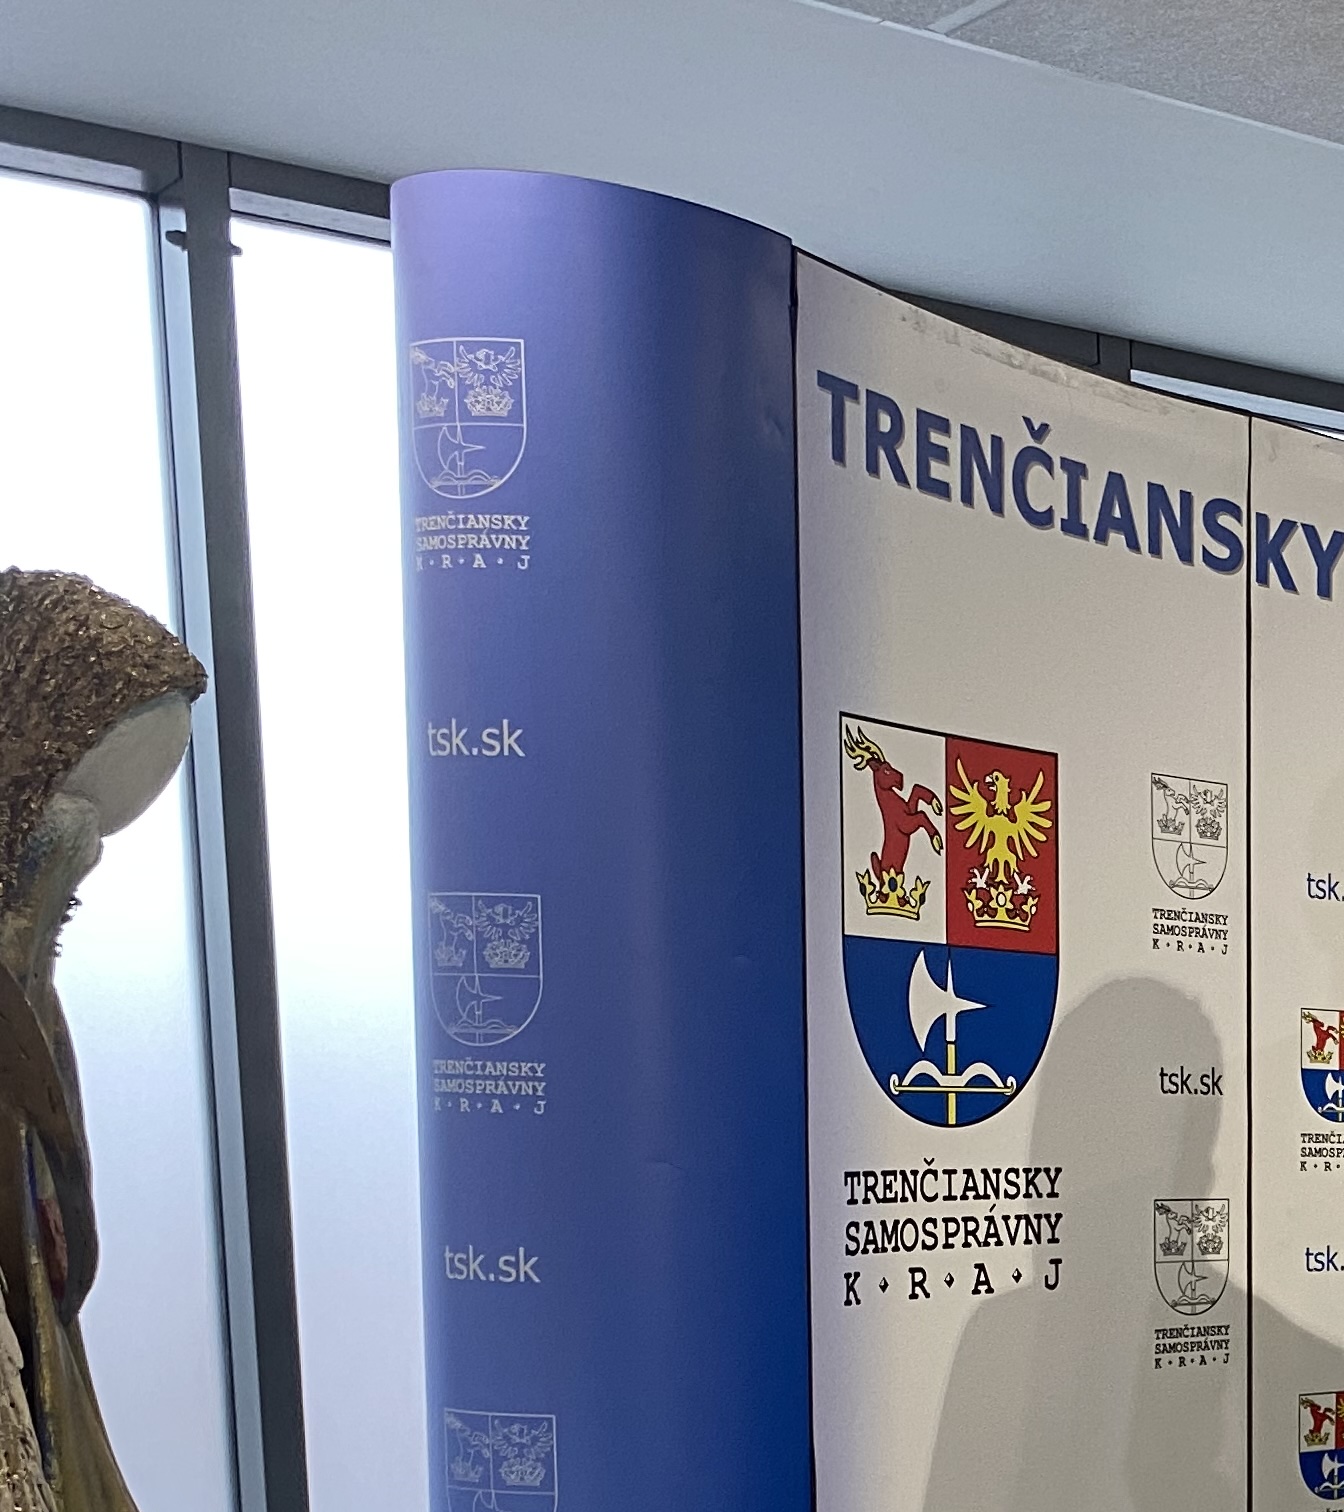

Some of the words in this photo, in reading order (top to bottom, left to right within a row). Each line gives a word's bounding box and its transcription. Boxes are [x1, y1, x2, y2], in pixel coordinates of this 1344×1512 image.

[415, 511, 530, 531] TRENČIANSKY
[416, 528, 530, 550] SAMOSPRÁVNY
[428, 717, 525, 757] tsk.sk
[1152, 907, 1228, 925] TRENČIANSKY
[1152, 923, 1228, 940] SAMOSPRÁVNY
[1159, 1066, 1223, 1096] tsk.sk
[843, 1157, 1063, 1206] TRENČIANSKY
[843, 1203, 1063, 1256] SAMOSPRÁVNY
[444, 1244, 540, 1283] tsk.sk
[1154, 1324, 1230, 1340] TRENČIANSKY
[1154, 1337, 1230, 1354] SAMOSPRÁVNY
